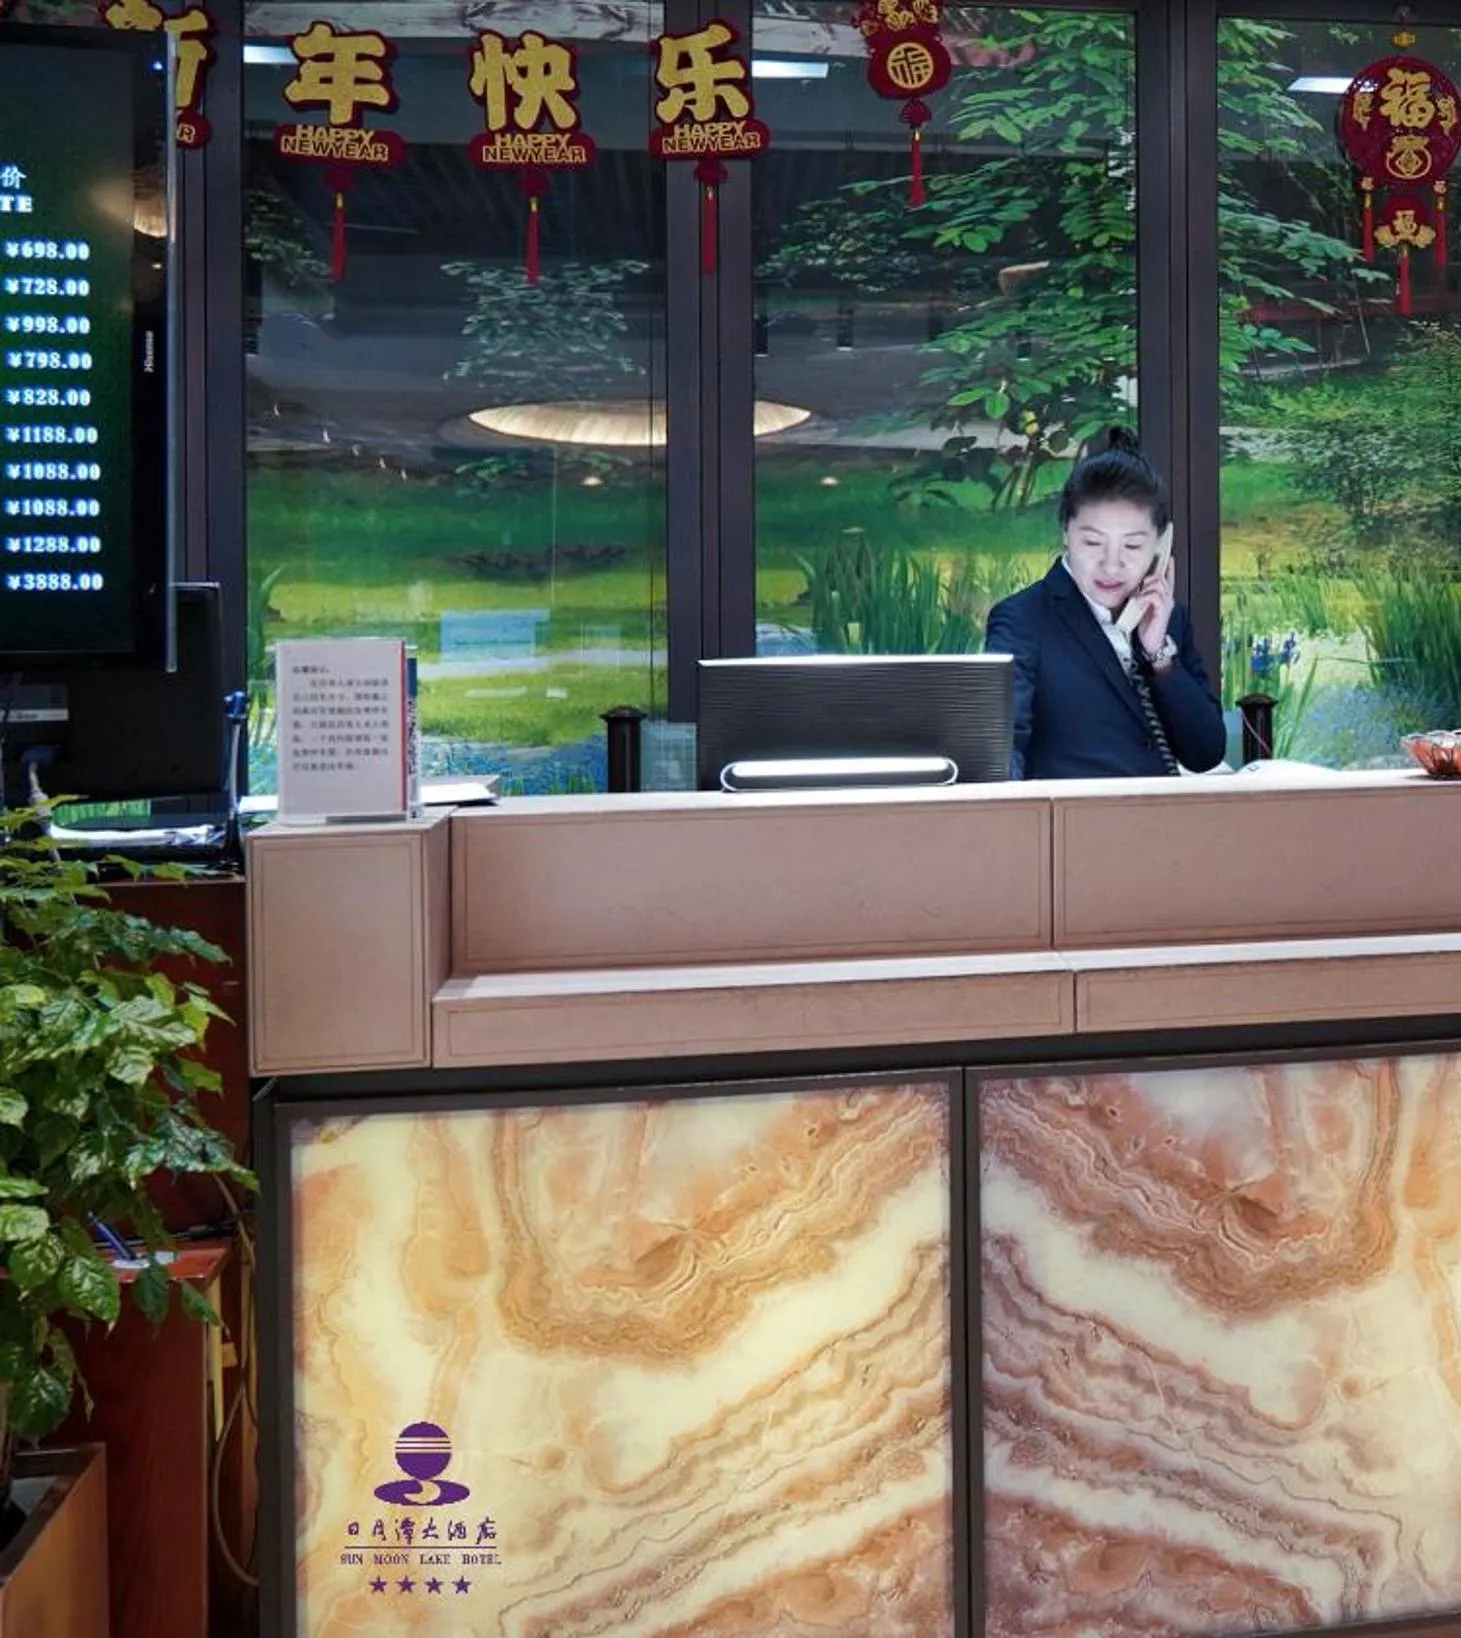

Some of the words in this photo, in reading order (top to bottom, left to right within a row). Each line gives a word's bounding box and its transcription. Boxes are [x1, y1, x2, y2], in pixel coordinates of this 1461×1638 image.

[1380, 67, 1436, 128] 福
[297, 125, 374, 143] HAPPY
[673, 121, 747, 140] HAPPY
[494, 133, 571, 149] HAPPY
[5, 241, 90, 260] ¥698.00
[5, 277, 90, 297] ¥728.00
[5, 315, 91, 335] ¥998.00
[8, 351, 93, 370] ¥798.00
[7, 387, 91, 406] ¥828.00
[6, 426, 98, 444] ¥1188.00
[7, 463, 101, 481] ¥1088.00
[6, 499, 100, 517] ¥1088.00
[8, 535, 101, 553] ¥1288.00
[8, 572, 104, 591] ¥3888.00
